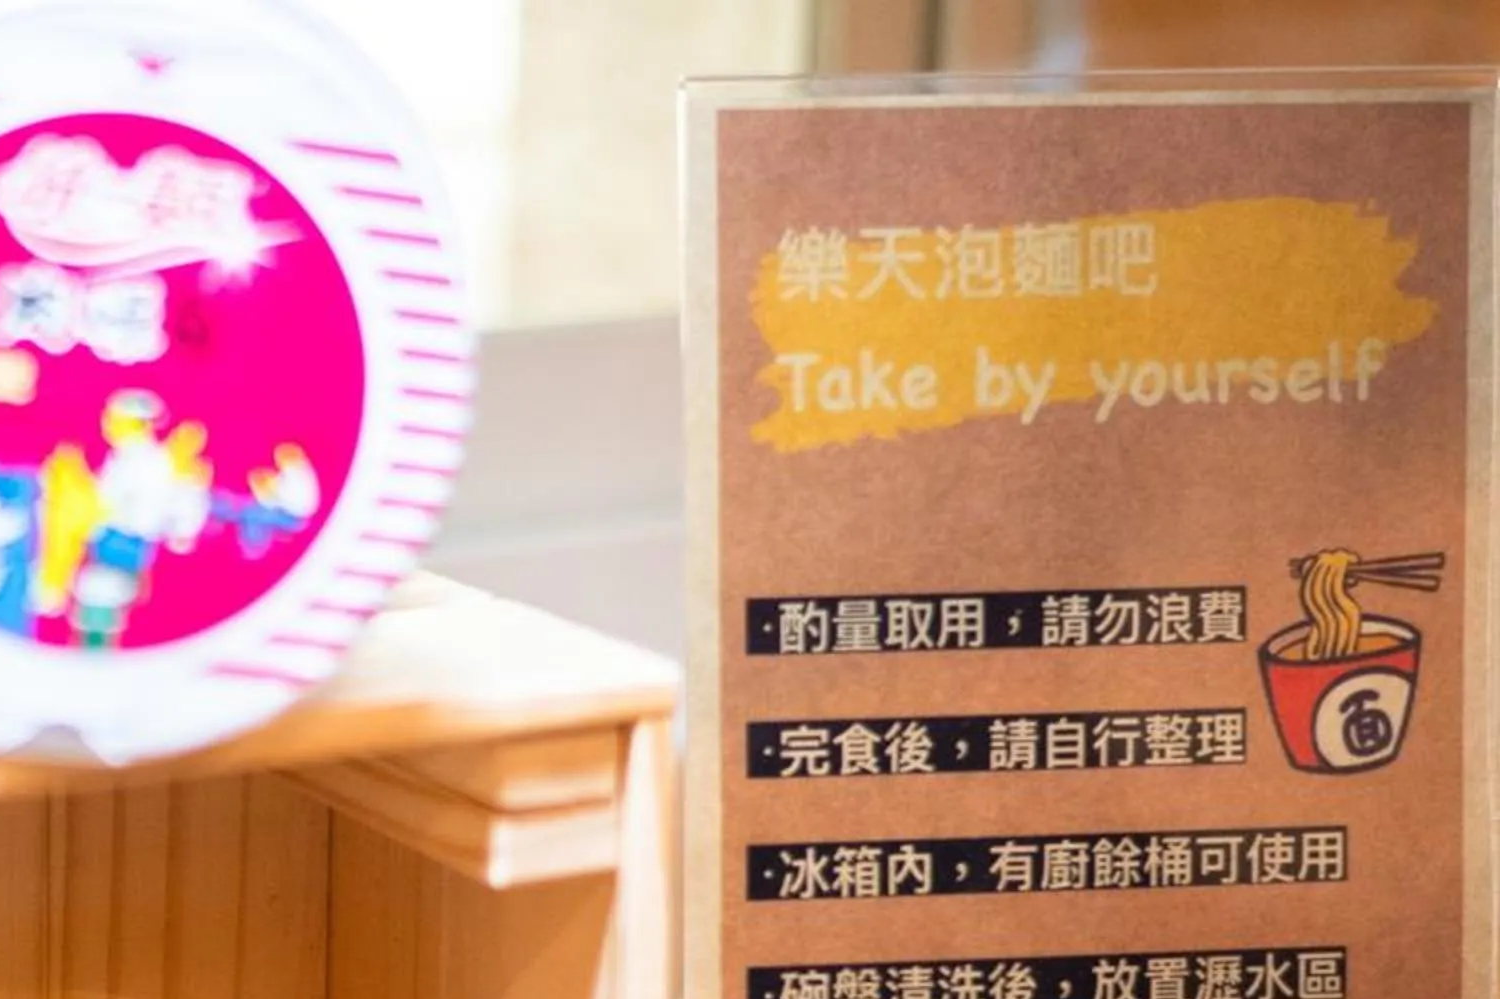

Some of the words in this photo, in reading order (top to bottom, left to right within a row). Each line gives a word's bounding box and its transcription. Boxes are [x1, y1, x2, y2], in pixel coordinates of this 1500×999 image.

[777, 222, 1158, 302] 樂天泡麵吧
[775, 348, 938, 413] Take
[976, 346, 1056, 424] by
[1089, 338, 1386, 422] yourself
